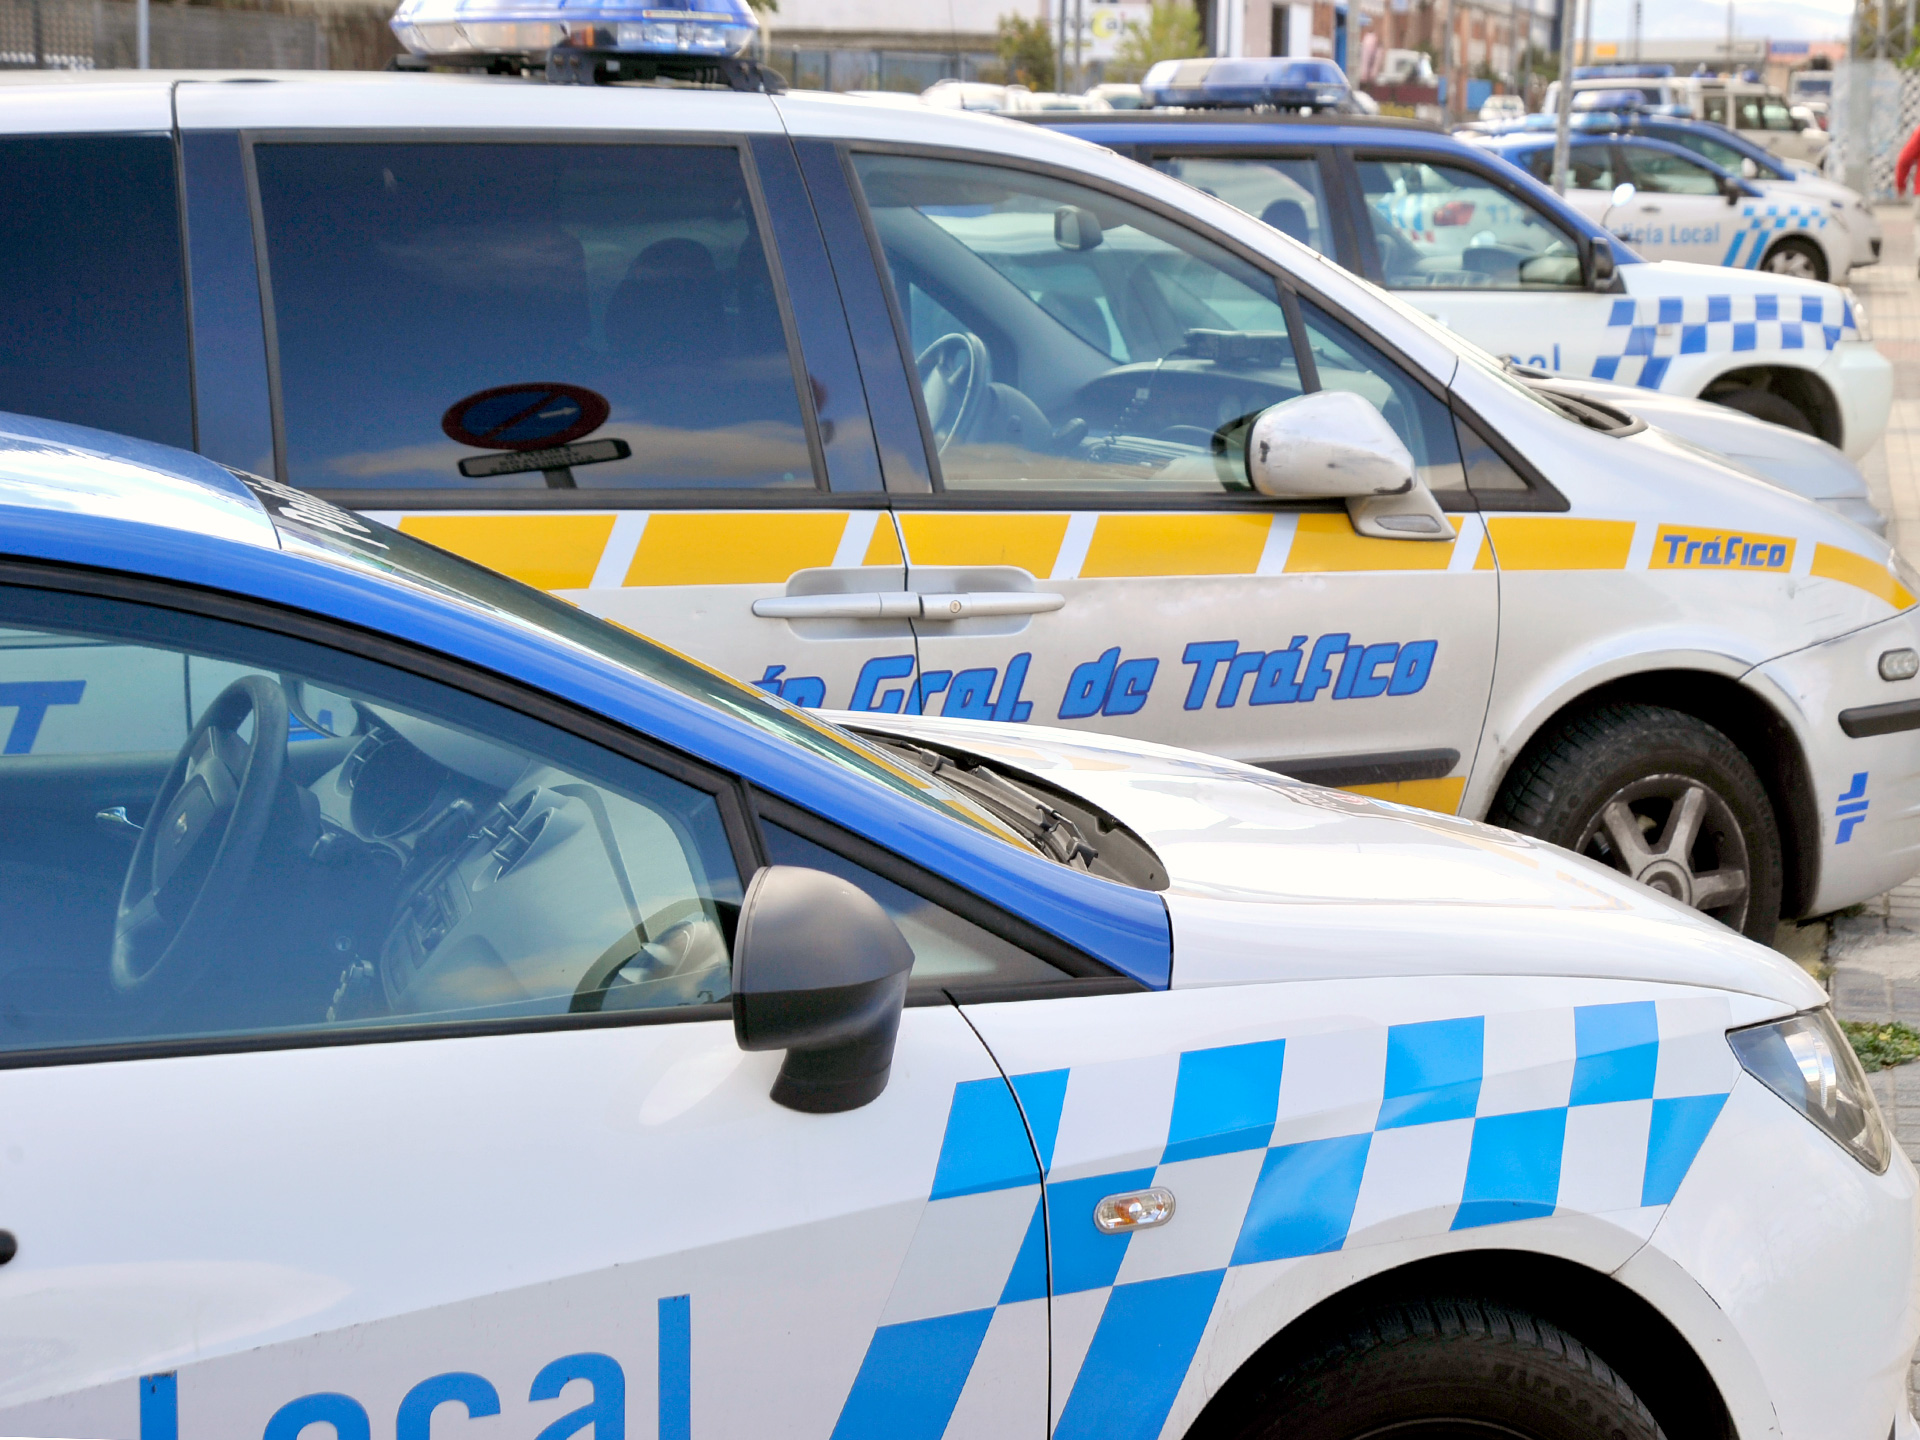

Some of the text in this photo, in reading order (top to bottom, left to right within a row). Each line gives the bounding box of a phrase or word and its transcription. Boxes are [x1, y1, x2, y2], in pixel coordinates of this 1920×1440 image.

[1669, 222, 1720, 245] Local
[1663, 534, 1787, 567] Tráfico
[1058, 647, 1159, 719] de
[1183, 633, 1438, 711] Tráfico
